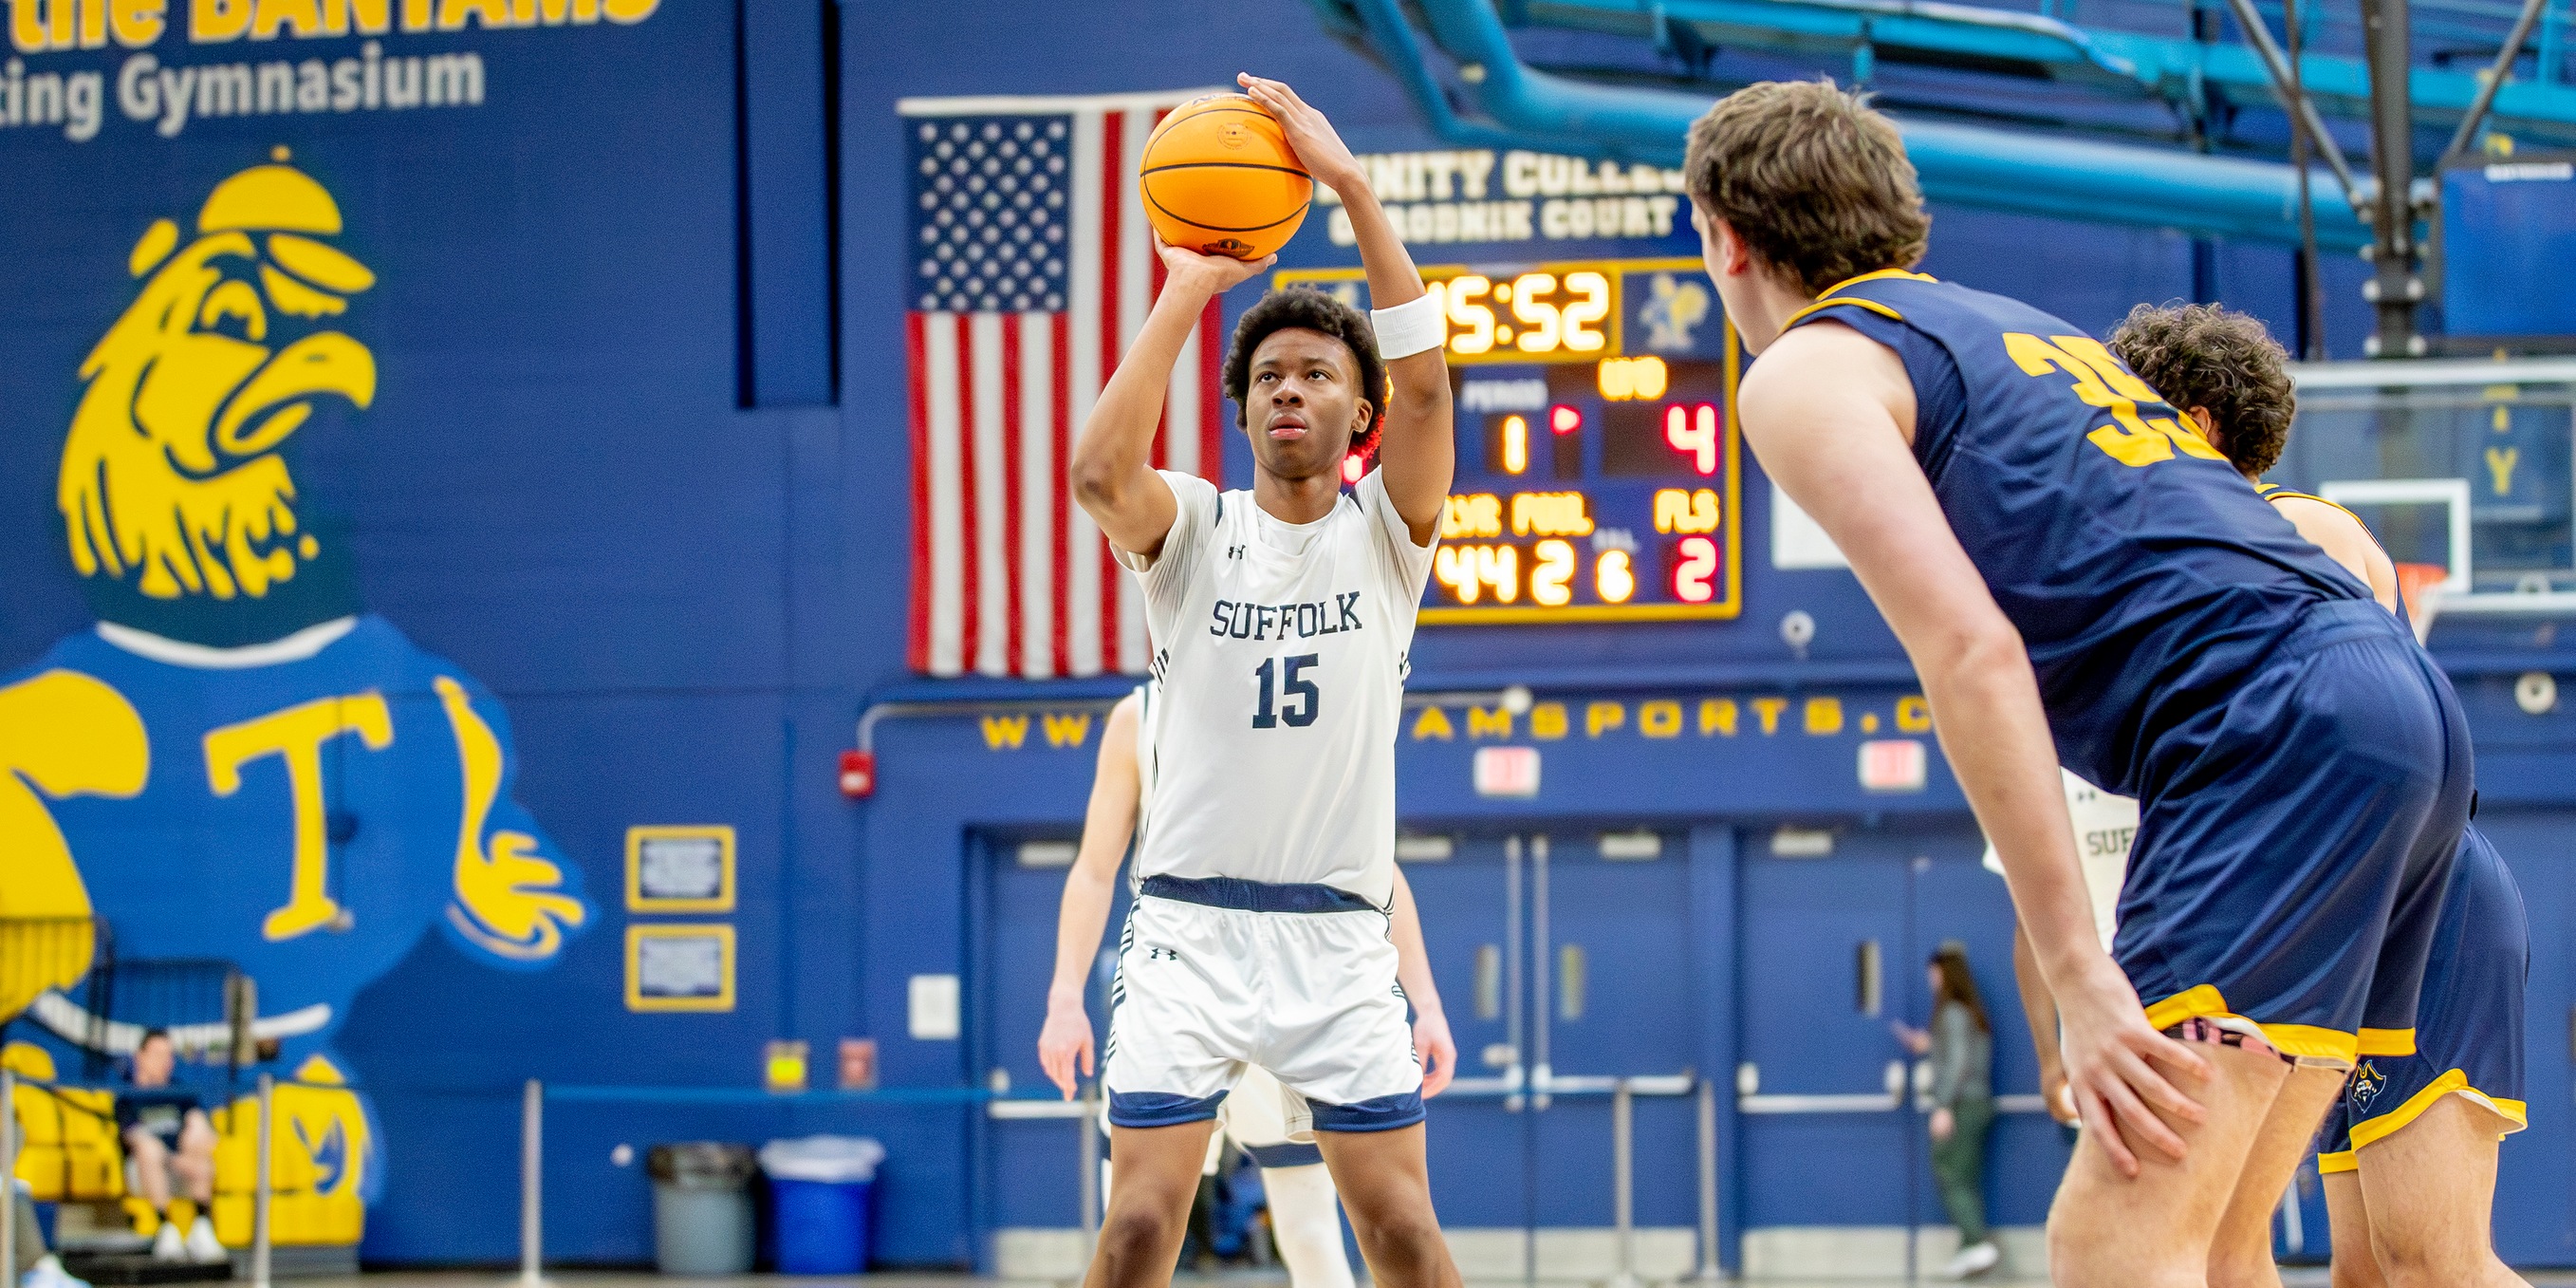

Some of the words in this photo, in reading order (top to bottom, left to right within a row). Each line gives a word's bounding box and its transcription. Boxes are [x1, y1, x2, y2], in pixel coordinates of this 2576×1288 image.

[117, 42, 486, 137] Gymnasium
[1540, 195, 1678, 240] COURT
[2002, 332, 2232, 468] 35
[1503, 415, 1528, 475] 1
[1667, 402, 1718, 476] 4
[1435, 545, 1518, 605] 44
[1531, 539, 1576, 607] 2
[1674, 534, 1719, 604] 2
[1209, 590, 1362, 641] SUFFOLK
[1251, 652, 1320, 730] 15
[203, 693, 394, 942] T
